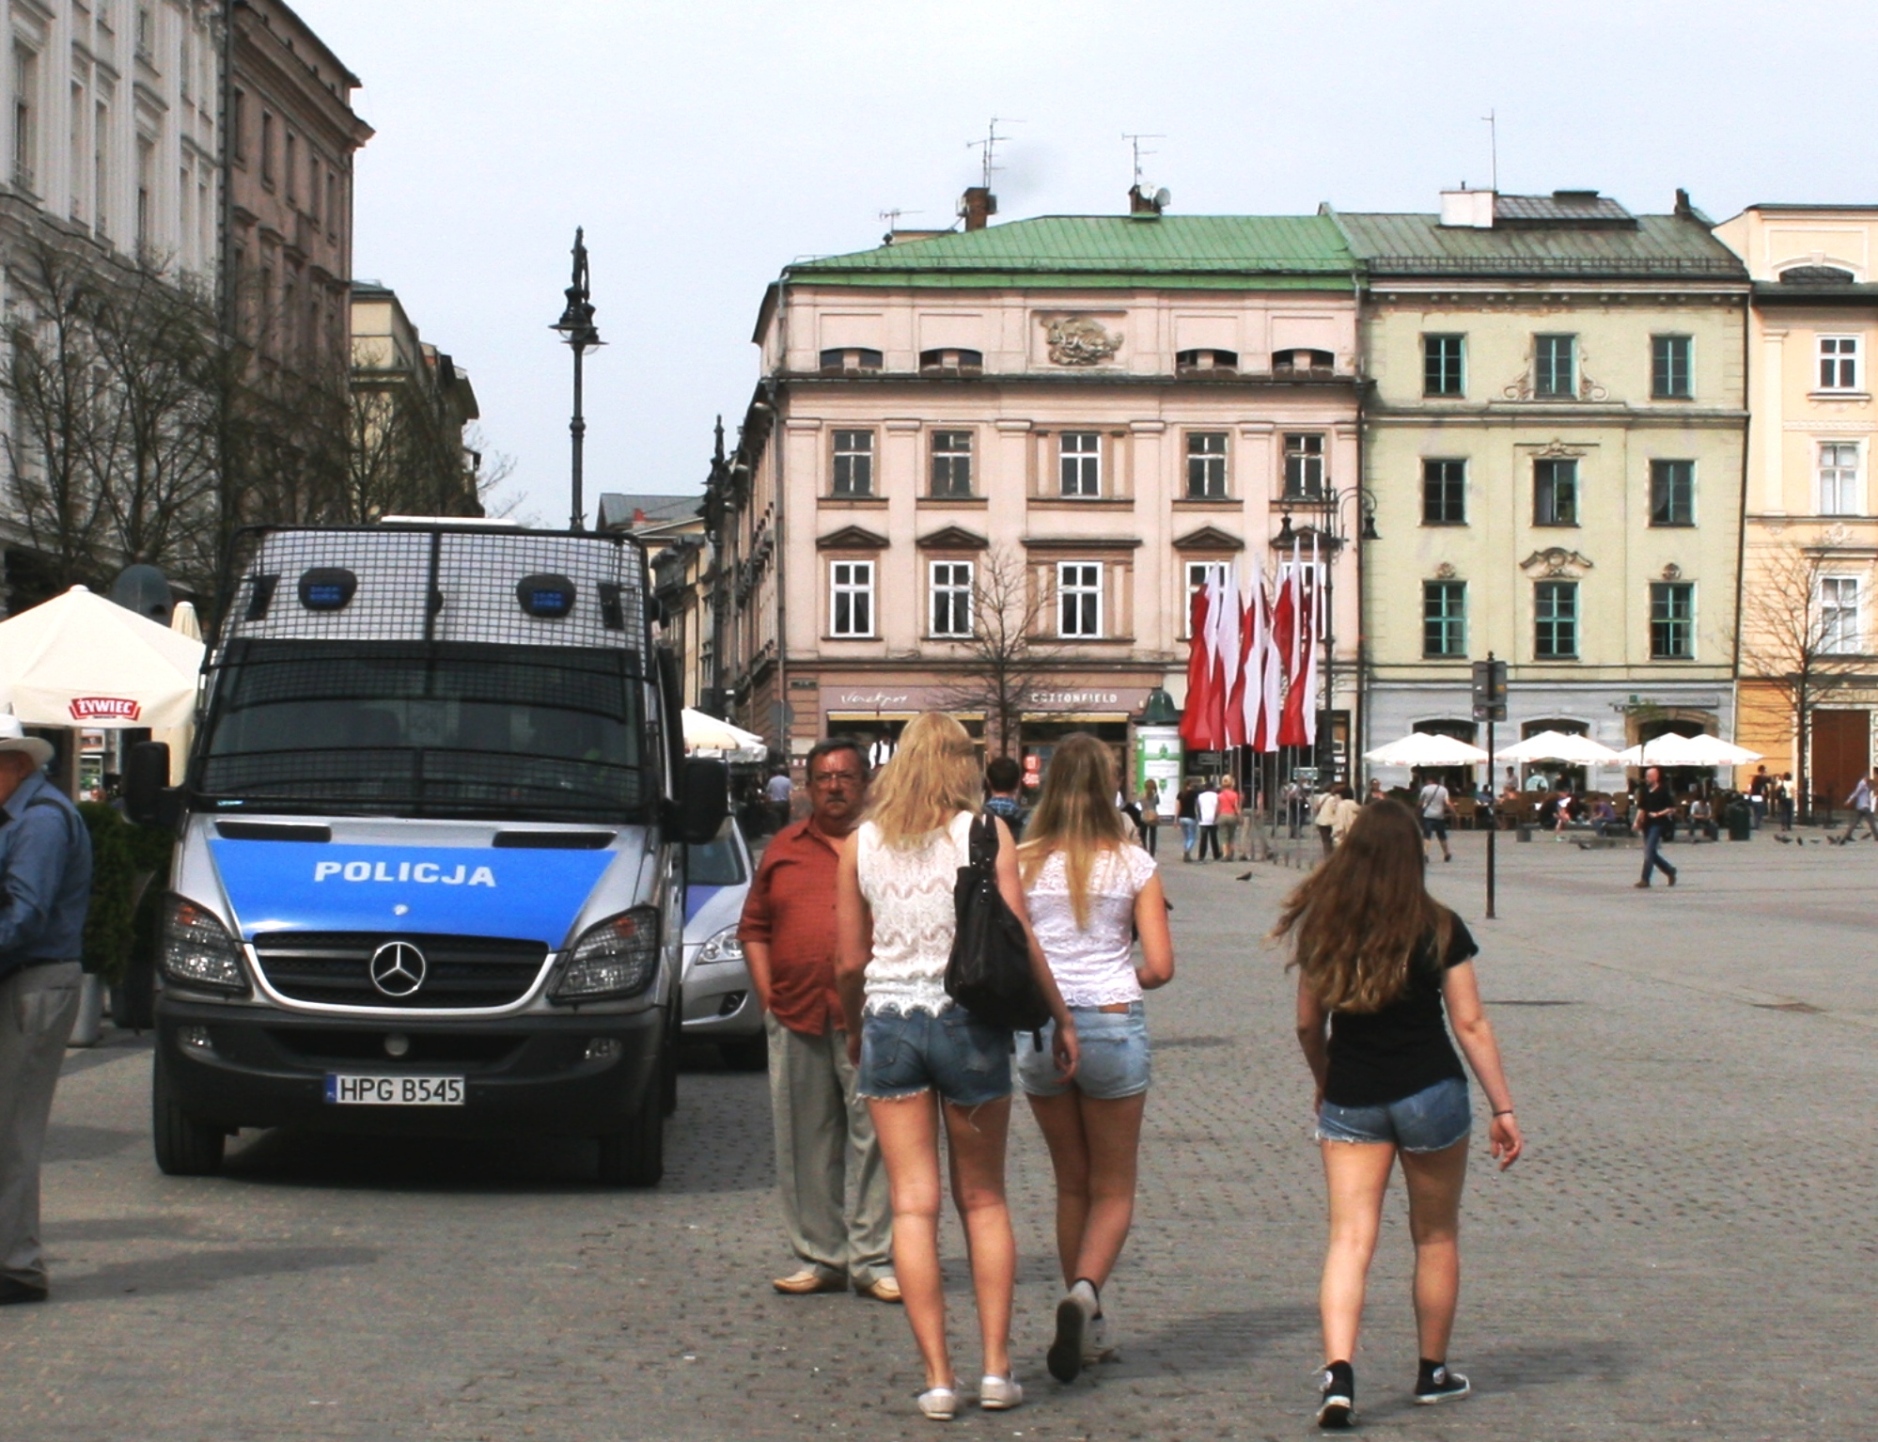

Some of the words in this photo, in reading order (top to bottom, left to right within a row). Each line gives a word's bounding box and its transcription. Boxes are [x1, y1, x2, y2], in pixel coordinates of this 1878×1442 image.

[77, 698, 133, 714] ŻYWIEC
[314, 861, 496, 887] POLICJA
[341, 1078, 394, 1102] HPG
[402, 1079, 461, 1102] B545
